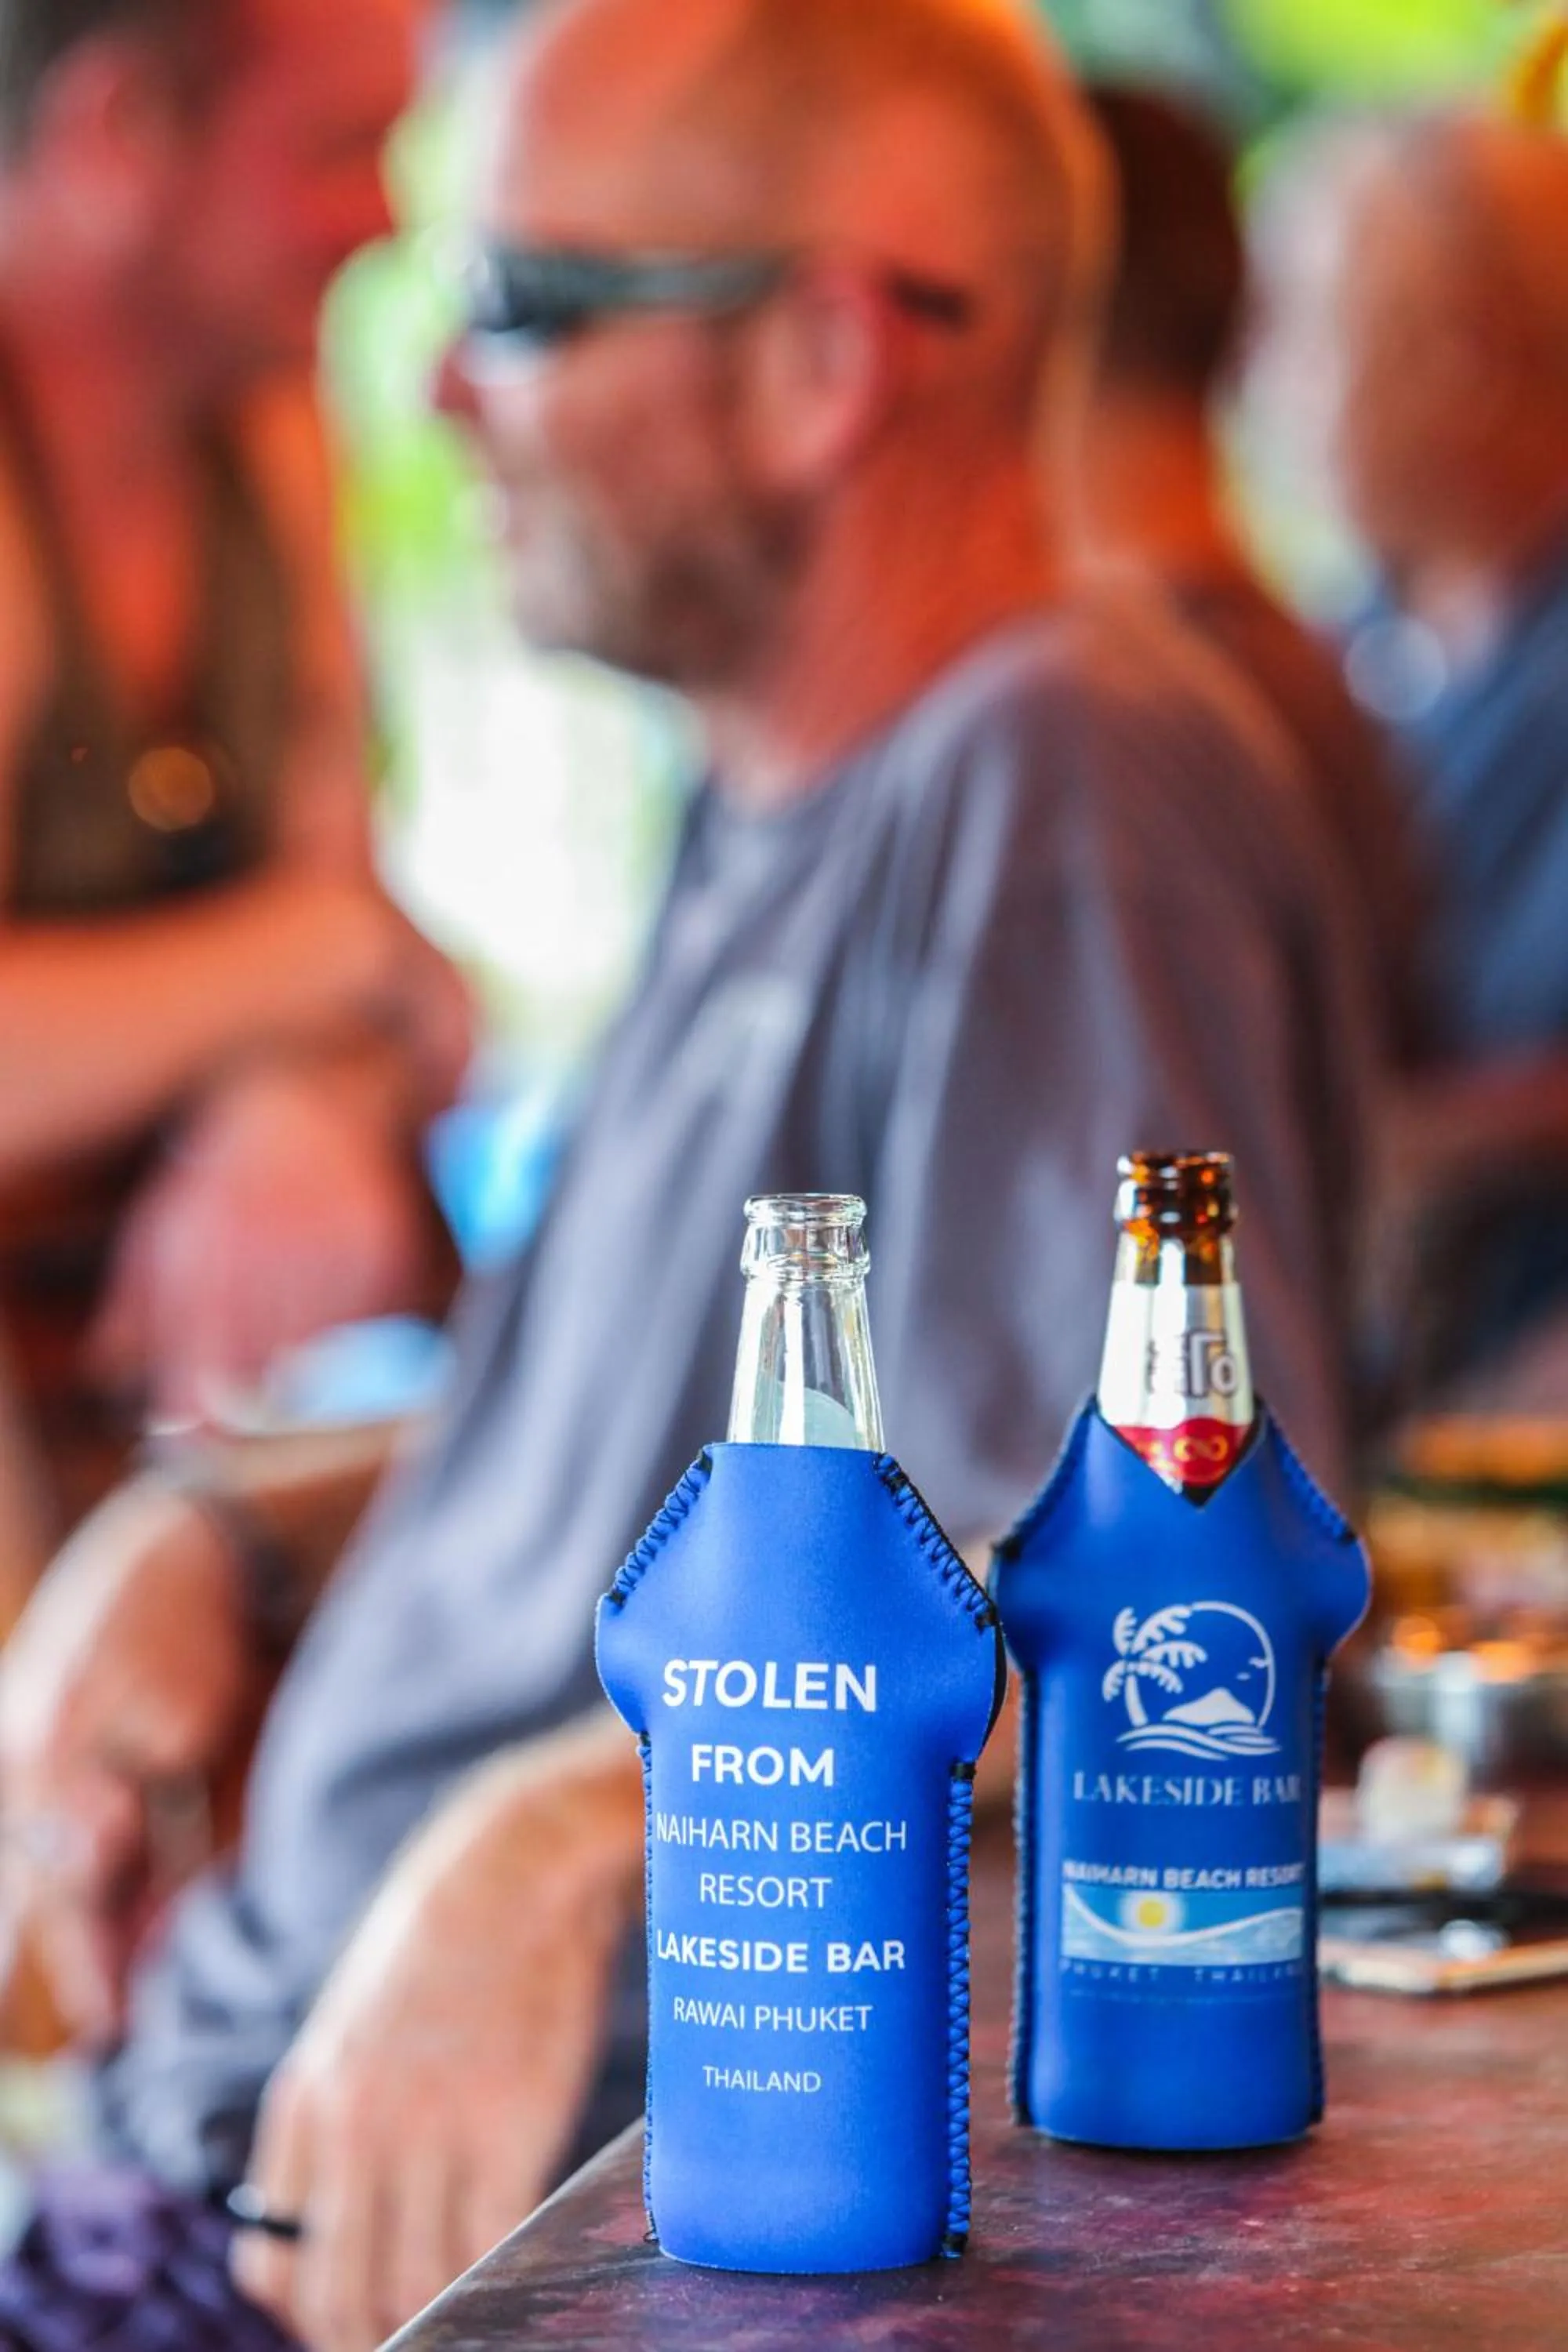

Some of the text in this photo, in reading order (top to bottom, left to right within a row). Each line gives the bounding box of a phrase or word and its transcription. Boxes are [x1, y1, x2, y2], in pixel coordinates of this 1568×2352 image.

[662, 1658, 877, 1712] STOLEN
[691, 1744, 835, 1787] FROM
[1073, 1770, 1245, 1806] LAKESIDE
[656, 1813, 907, 1853] NAIHARN BEACH
[699, 1873, 833, 1908] RESORT
[1163, 1867, 1242, 1889] BEACH
[656, 1929, 906, 1973] LAKESIDE BAR
[673, 1997, 873, 2032] RAWAI PHUKET
[702, 2065, 822, 2092] THAILAND
